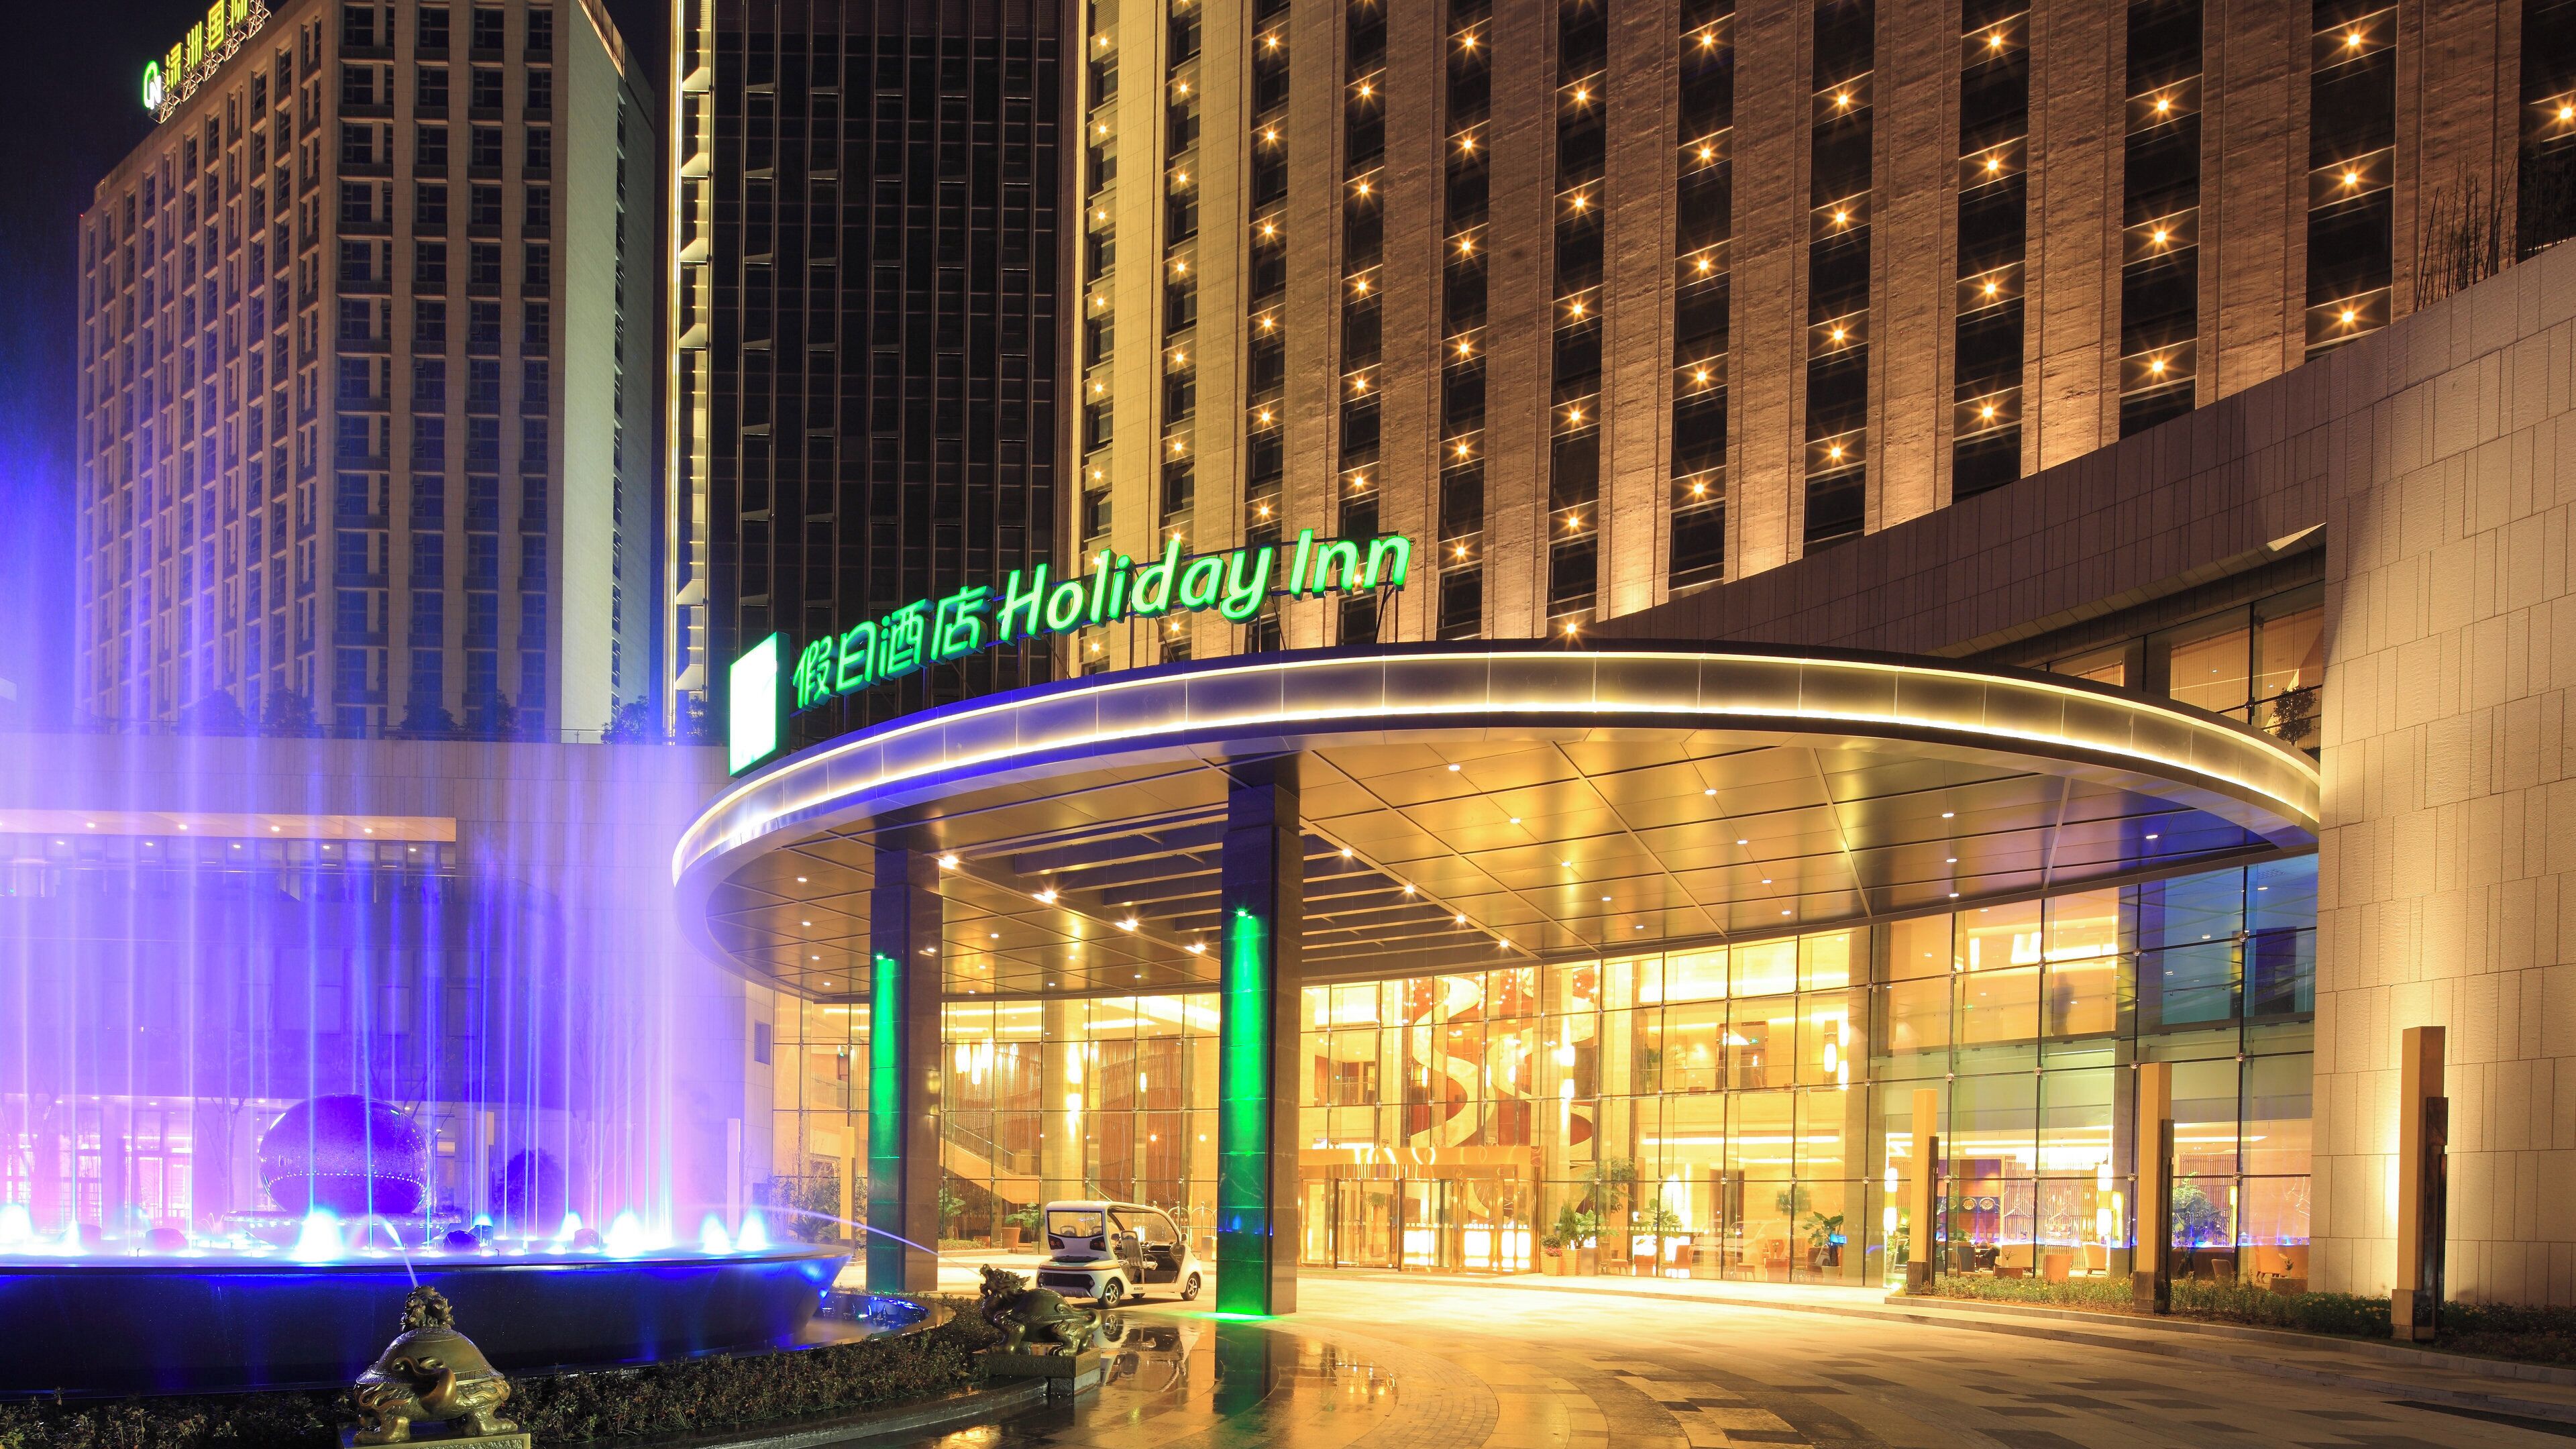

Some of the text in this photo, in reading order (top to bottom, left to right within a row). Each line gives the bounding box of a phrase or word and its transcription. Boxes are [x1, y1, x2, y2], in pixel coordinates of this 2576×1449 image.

[996, 528, 1411, 641] Holiday Inn
[792, 585, 988, 709] 假日酒店
